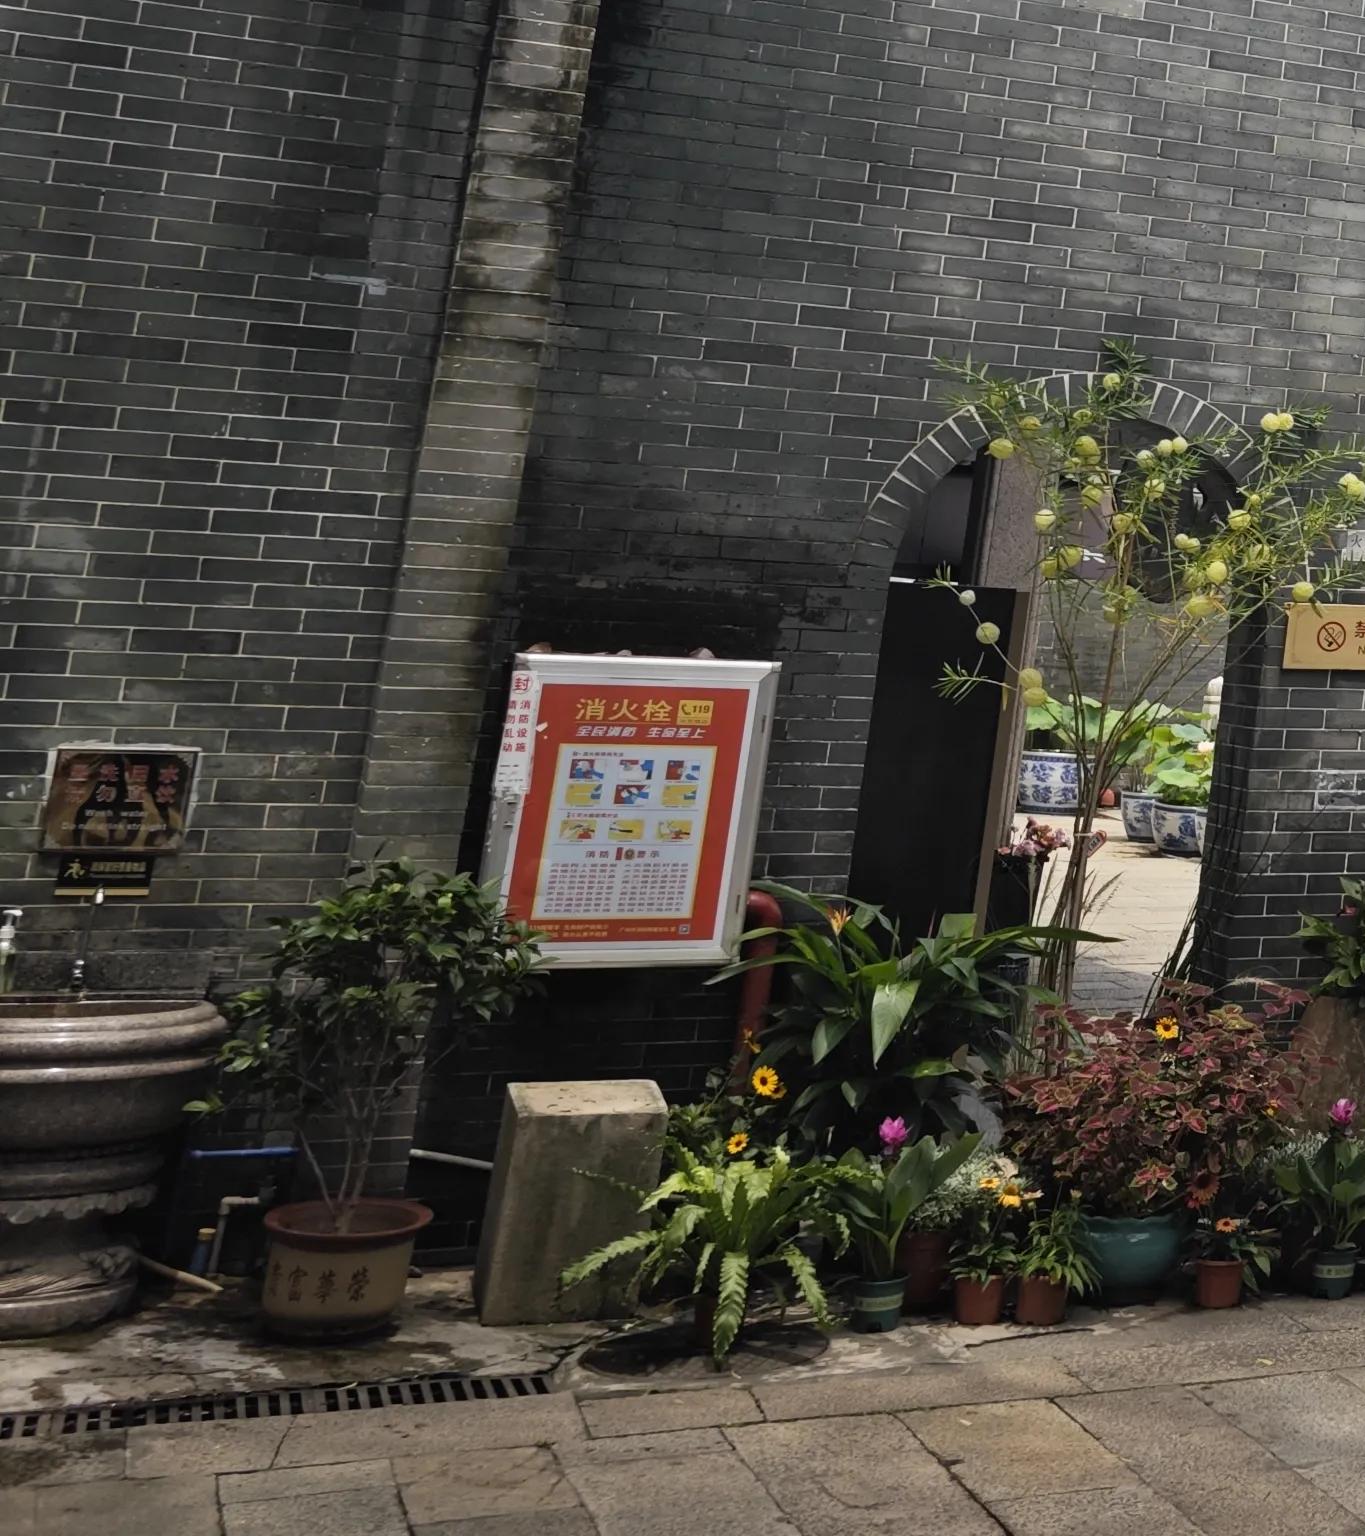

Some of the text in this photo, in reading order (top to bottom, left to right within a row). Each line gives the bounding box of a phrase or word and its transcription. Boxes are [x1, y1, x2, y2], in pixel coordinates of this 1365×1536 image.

[514, 676, 531, 691] 封
[575, 698, 710, 722] 消火栓 119
[576, 725, 707, 739] 全民消防 生命至上
